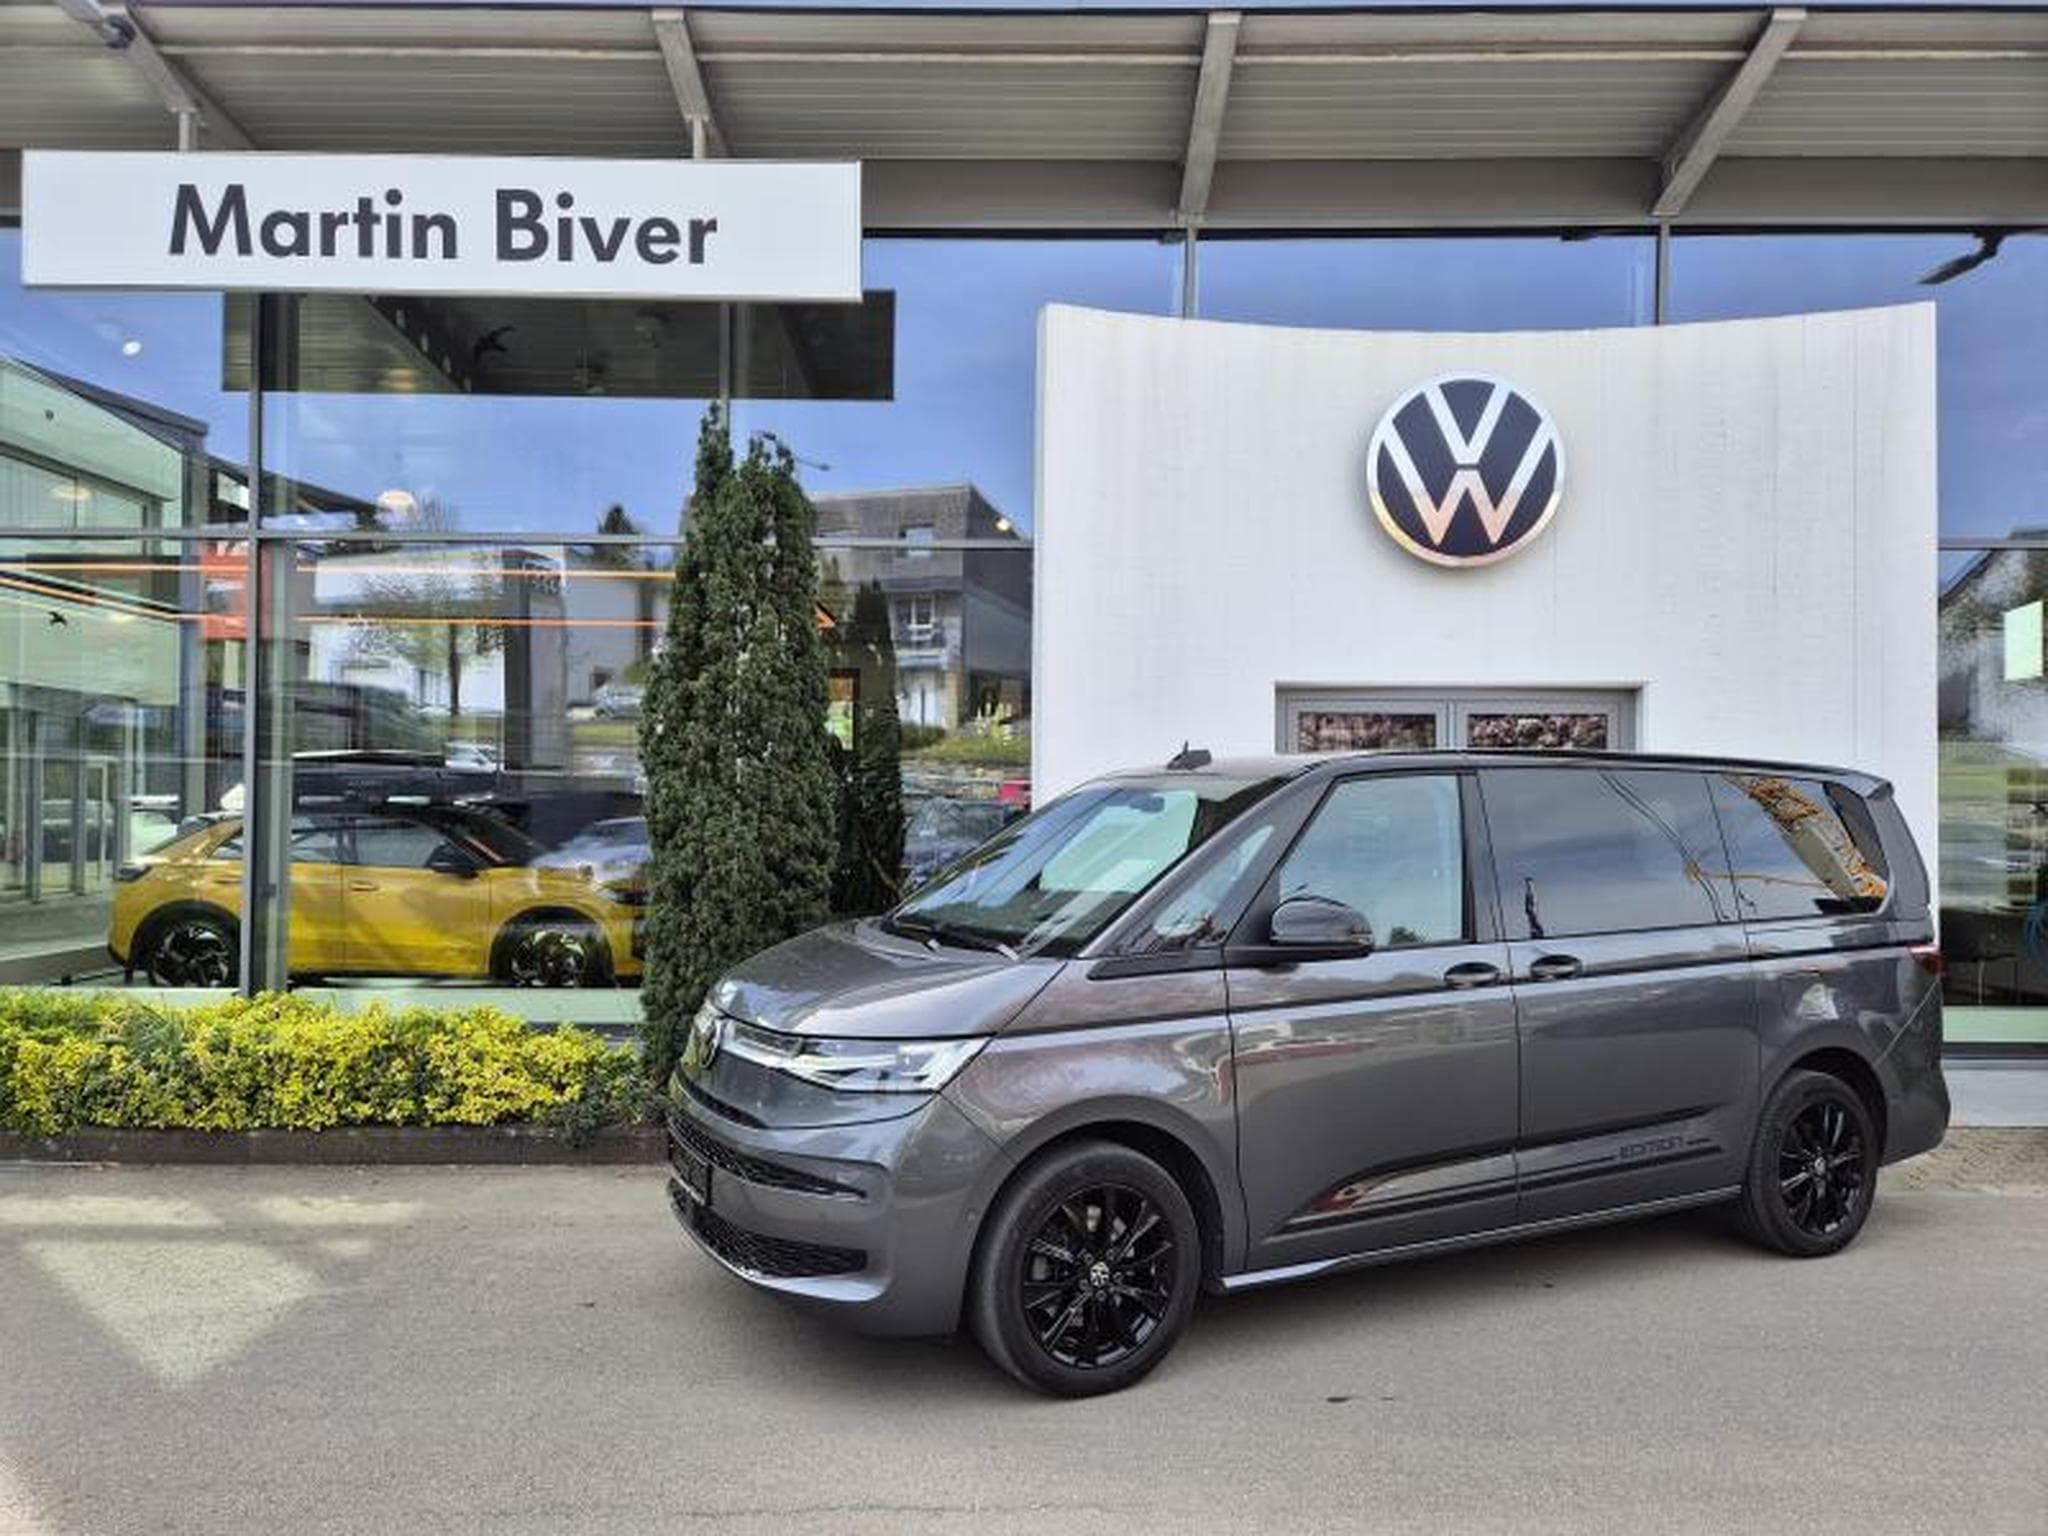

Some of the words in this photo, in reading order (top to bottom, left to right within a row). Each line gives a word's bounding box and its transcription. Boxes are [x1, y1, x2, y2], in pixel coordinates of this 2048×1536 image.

[169, 183, 458, 259] Martin
[495, 188, 718, 265] Biver
[1373, 374, 1561, 558] VW
